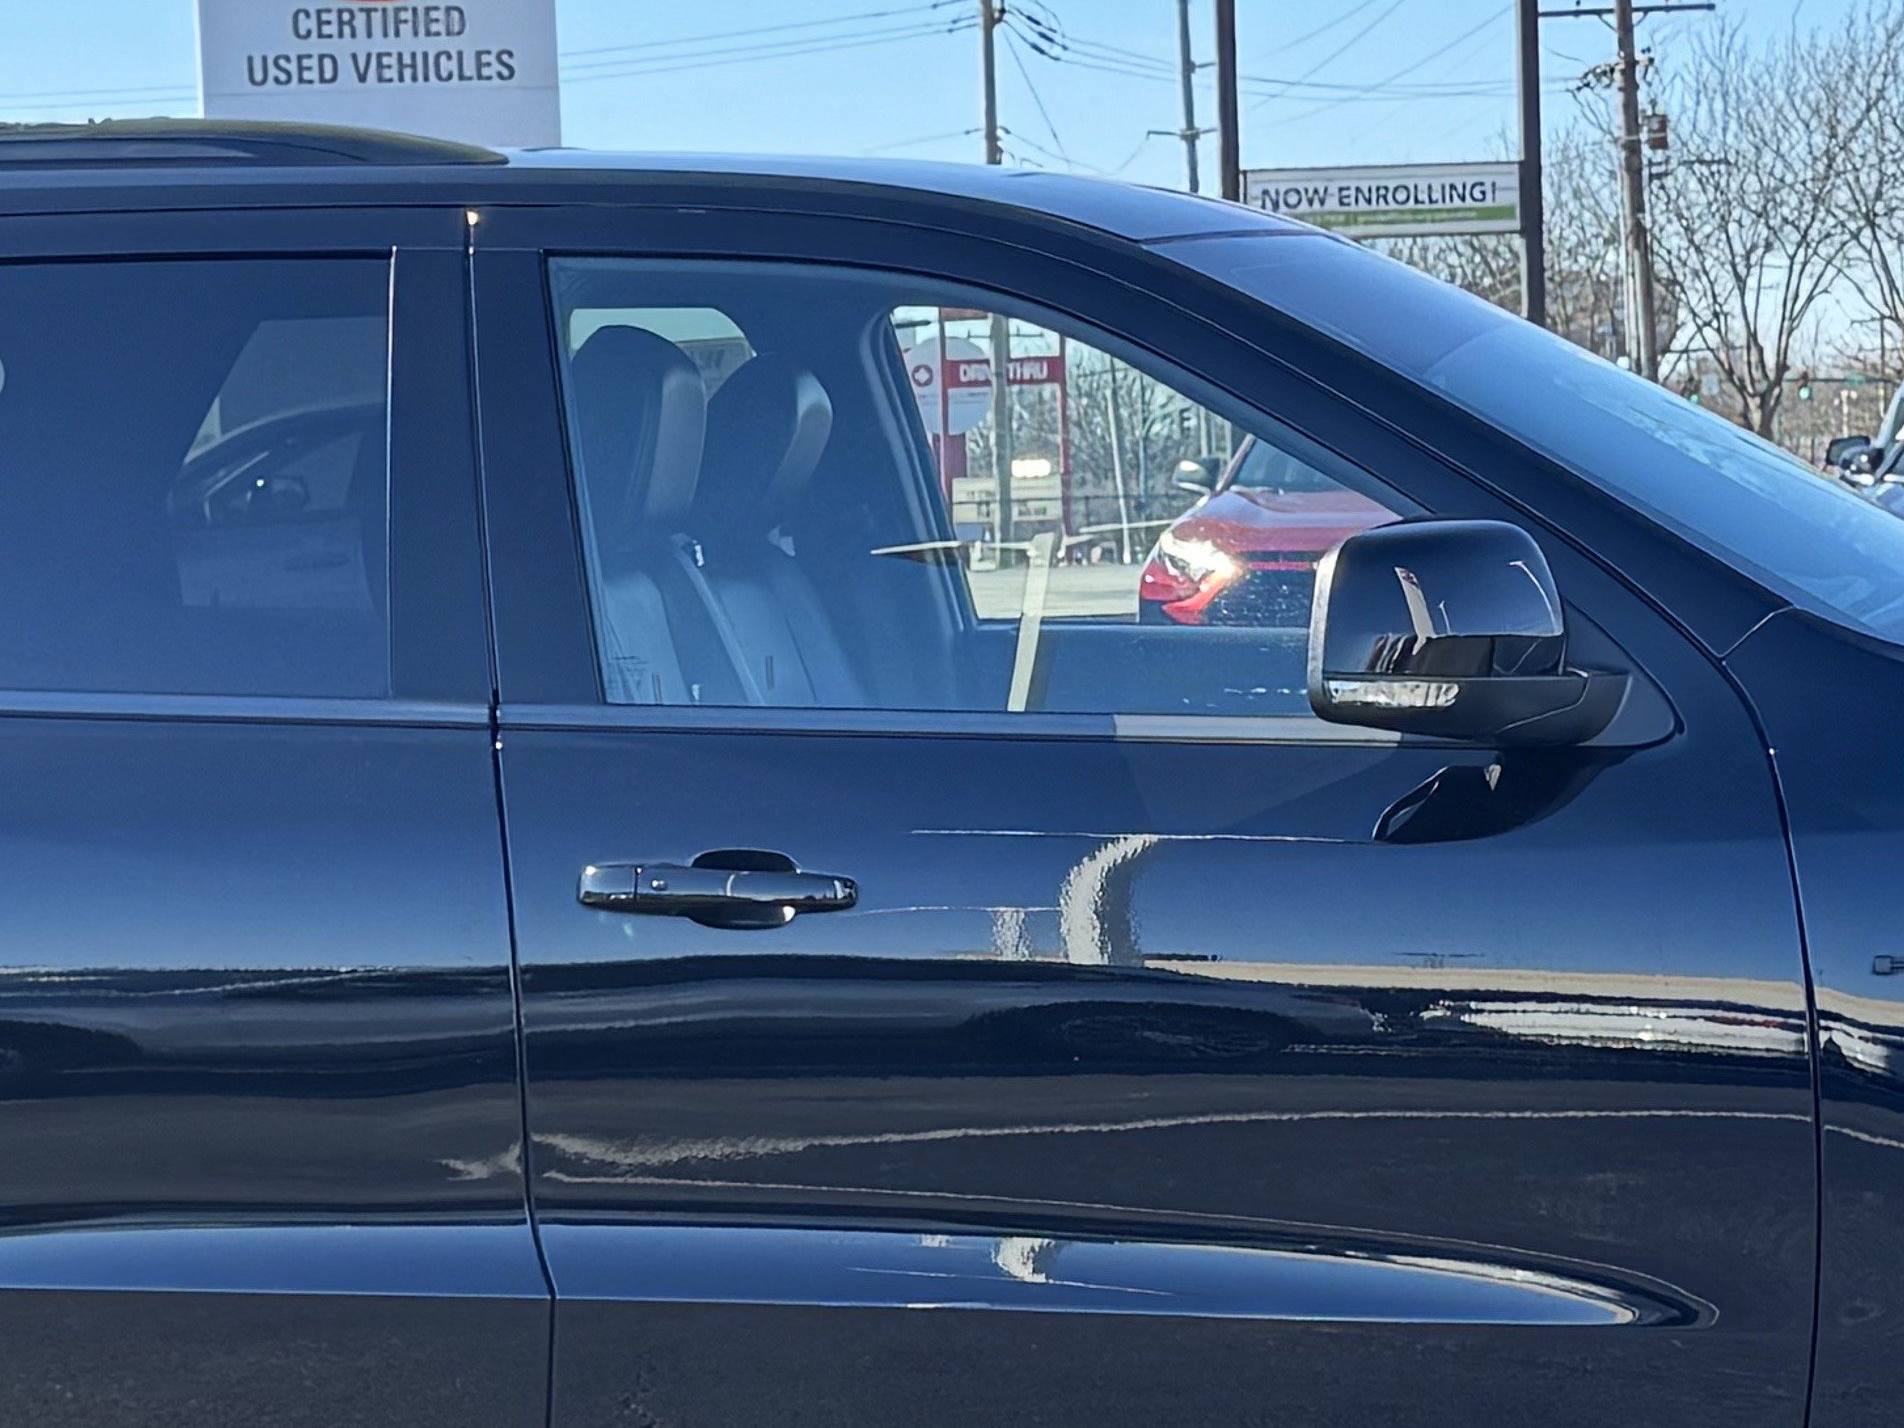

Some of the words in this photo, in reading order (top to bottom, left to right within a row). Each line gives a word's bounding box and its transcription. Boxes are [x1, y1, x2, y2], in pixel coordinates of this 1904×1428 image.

[290, 5, 467, 41] CERTIFIED
[245, 52, 339, 87] USED
[350, 48, 517, 85] VEHICLES
[1260, 186, 1329, 213] NOW
[1337, 180, 1496, 208] ENROLLING!
